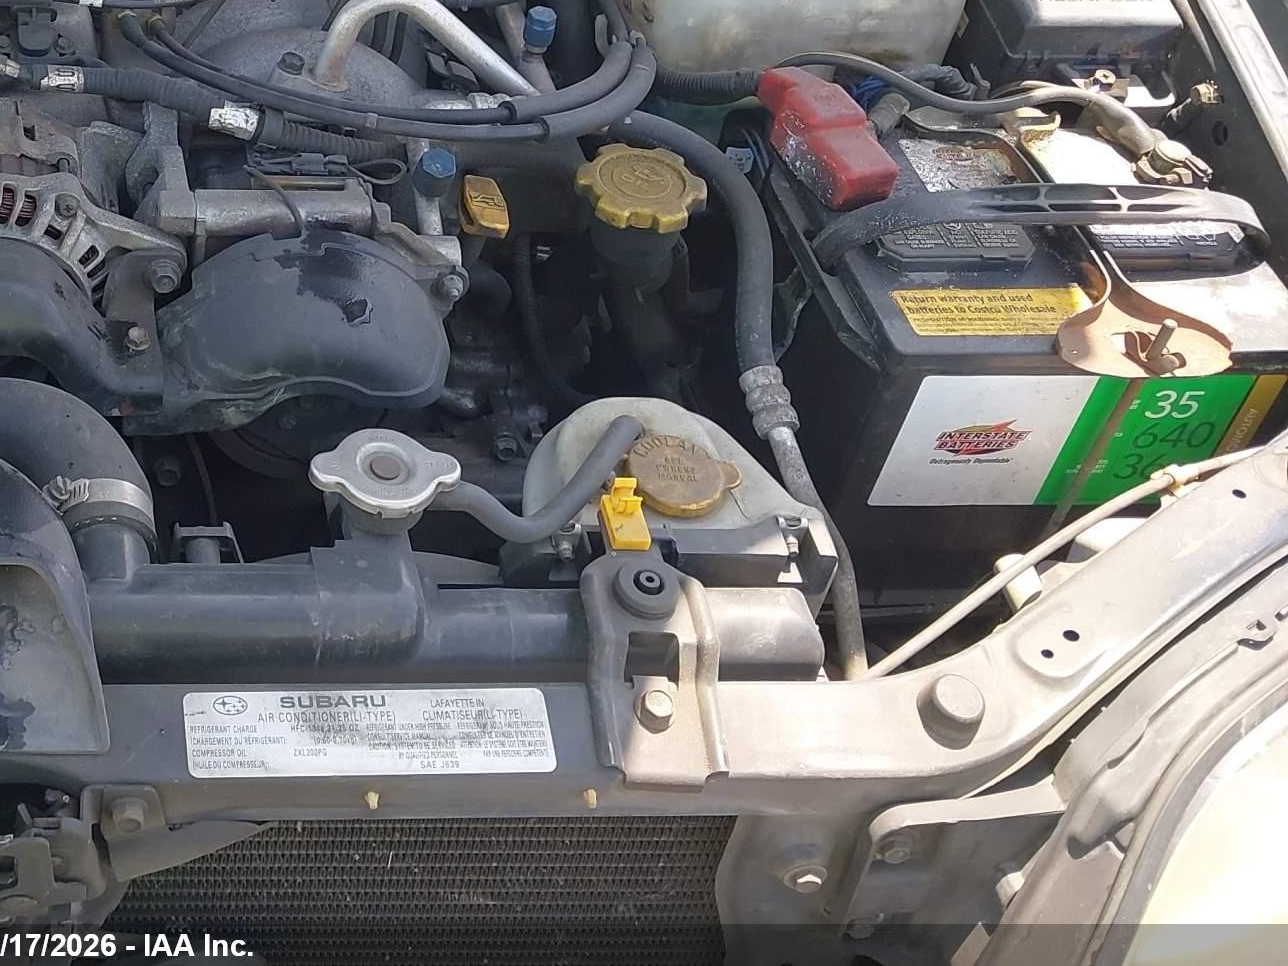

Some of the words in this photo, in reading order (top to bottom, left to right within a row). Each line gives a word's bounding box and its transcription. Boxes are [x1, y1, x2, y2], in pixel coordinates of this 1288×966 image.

[901, 295, 936, 304] Return
[939, 295, 985, 305] warranty
[987, 294, 1007, 303] and
[1009, 293, 1033, 302] used
[907, 305, 954, 315] batteries
[956, 305, 966, 314] to
[968, 304, 1002, 314] Costco
[1003, 304, 1057, 314] Wholesale
[1144, 390, 1206, 420] 35
[937, 432, 1026, 441] INTERSTATE
[1132, 421, 1216, 450] 640
[937, 441, 1015, 450] BATTERIES
[280, 695, 386, 708] SUBARU
[258, 712, 275, 723] AIR
[190, 725, 231, 734] REFRIGERANT
[232, 725, 258, 733] CHARGE
[192, 749, 234, 757] COMPRESSOR
[236, 749, 247, 757] OIL
[420, 761, 437, 769] SAE
[441, 760, 459, 768] J639
